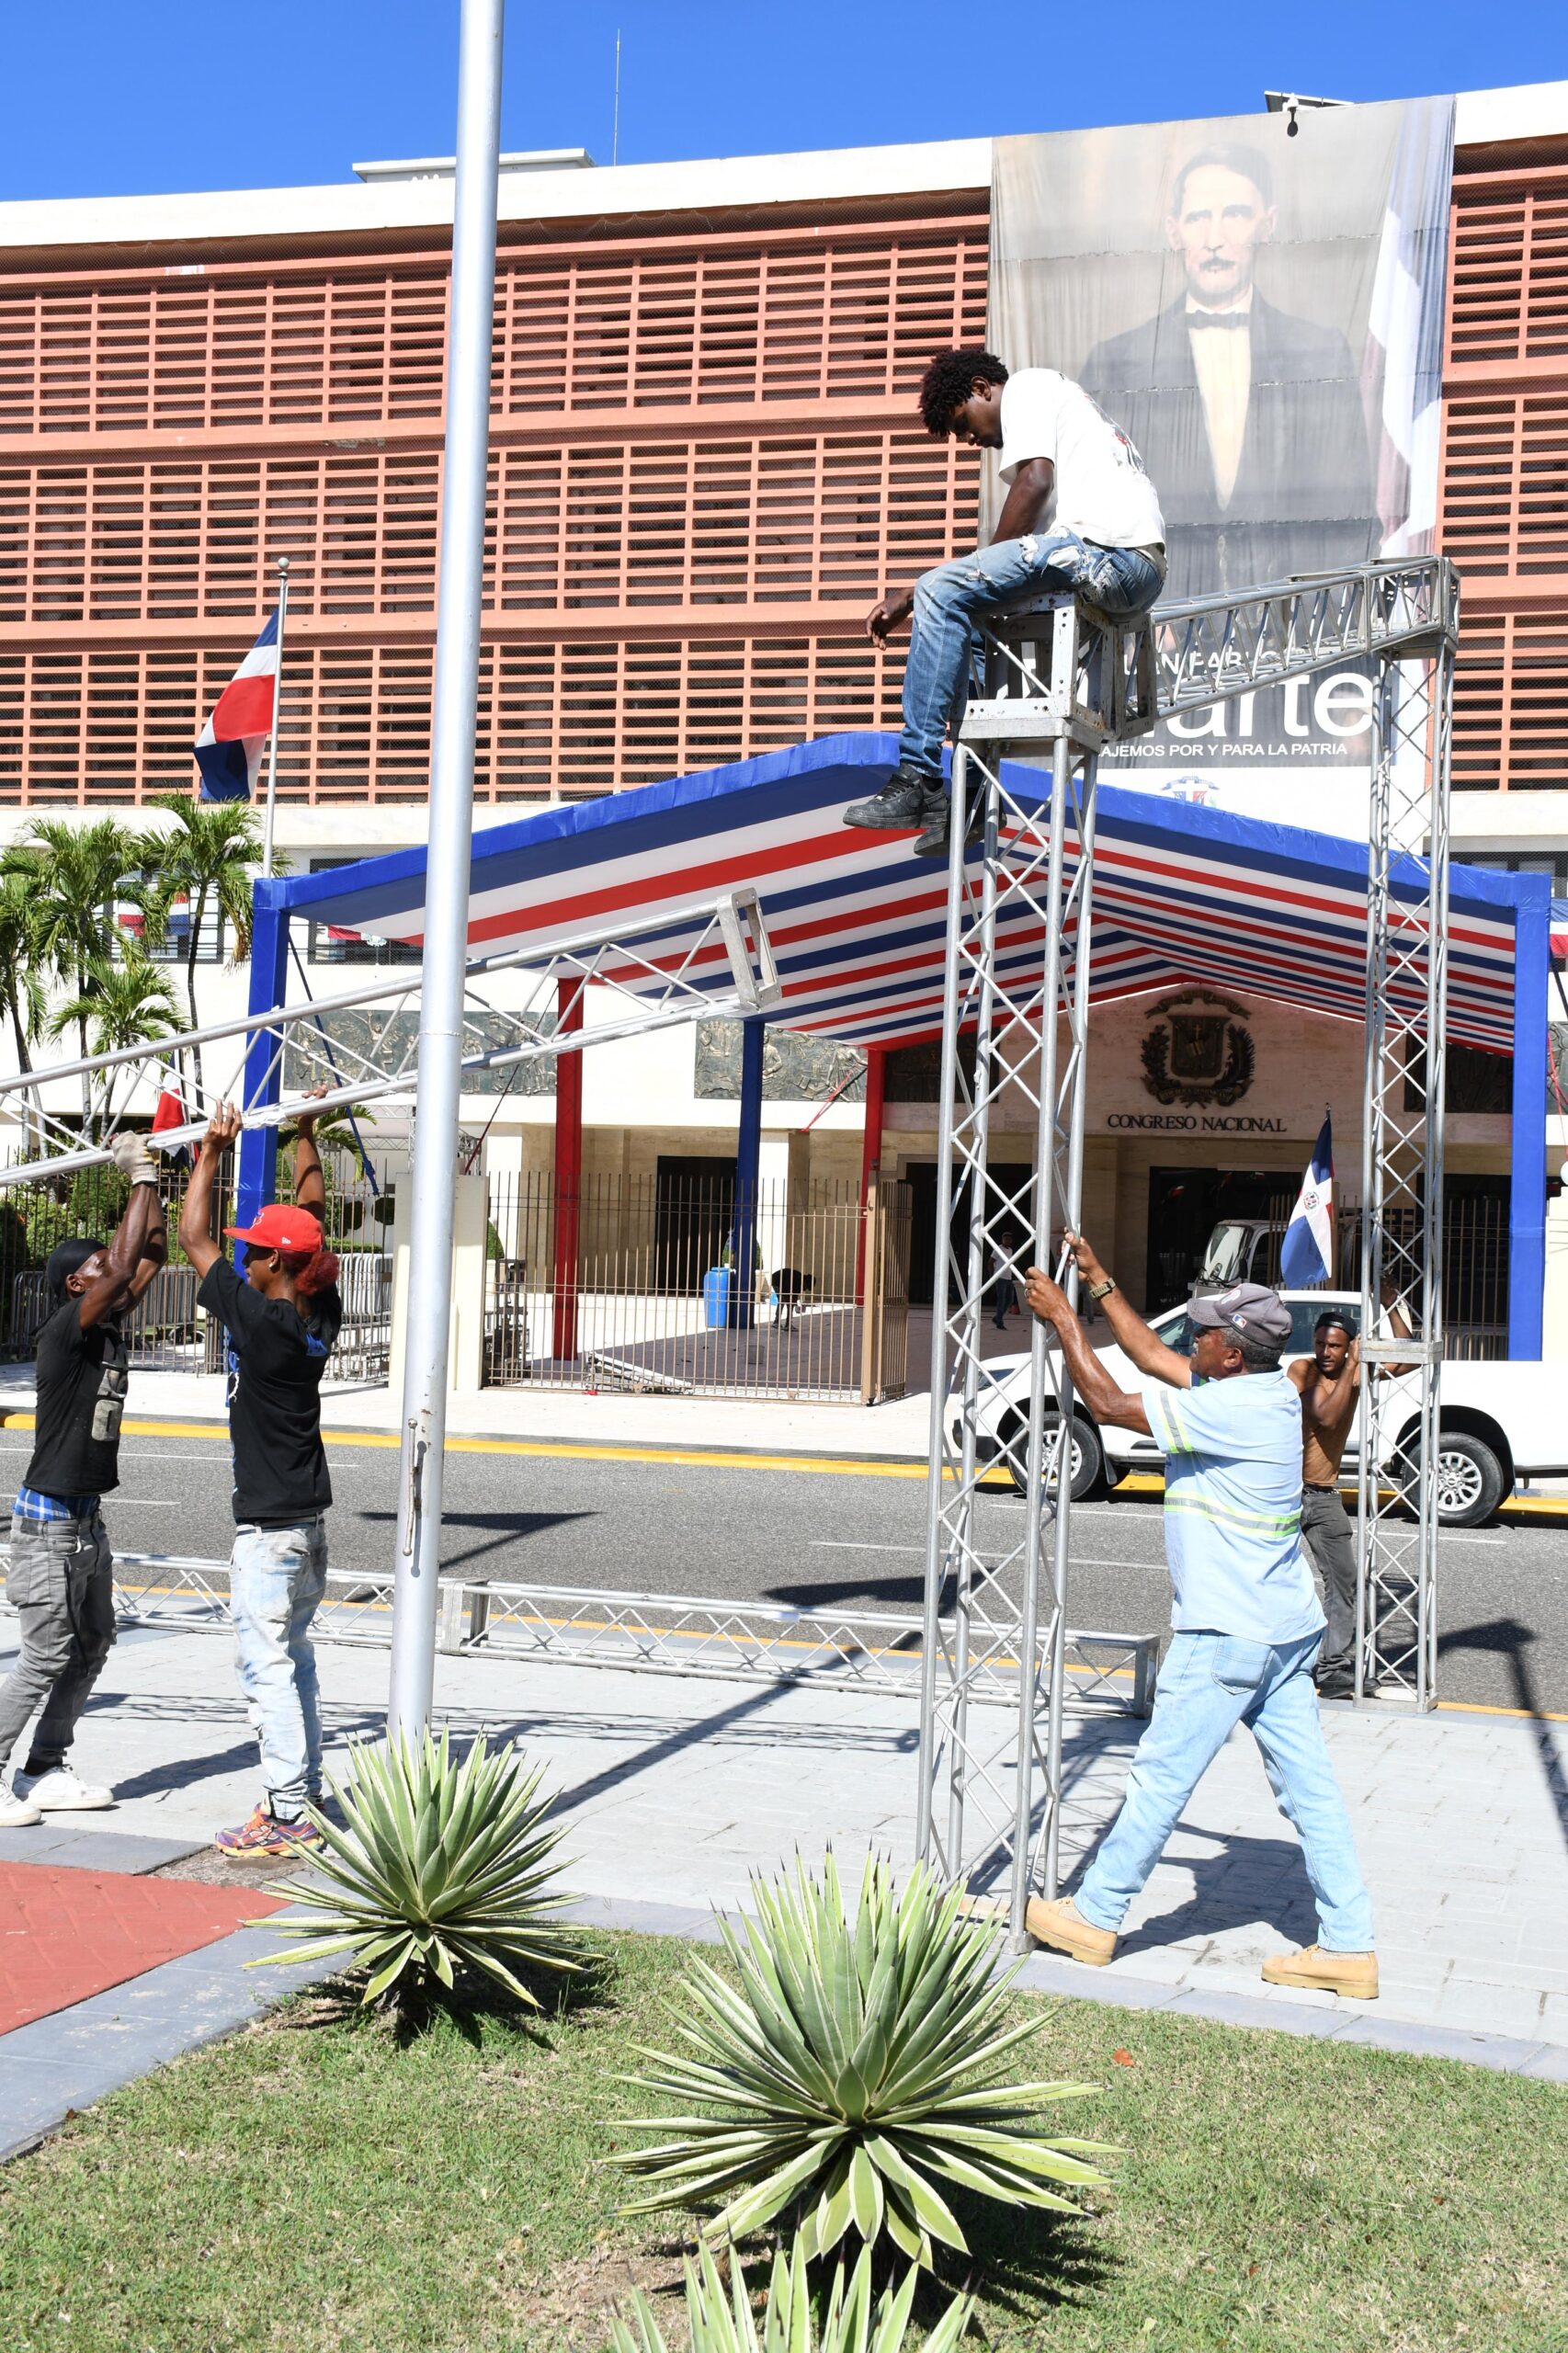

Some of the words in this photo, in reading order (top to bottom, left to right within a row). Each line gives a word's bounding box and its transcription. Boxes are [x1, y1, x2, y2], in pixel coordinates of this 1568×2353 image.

[1131, 670, 1373, 738] arte
[1169, 744, 1204, 756] POR
[1207, 744, 1219, 756] Y
[1221, 744, 1266, 756] PARA
[1267, 743, 1289, 756] LA
[1290, 742, 1348, 756] PATRIA
[1107, 1114, 1197, 1130] CONGRESO
[1201, 1116, 1288, 1132] NACIONAL
